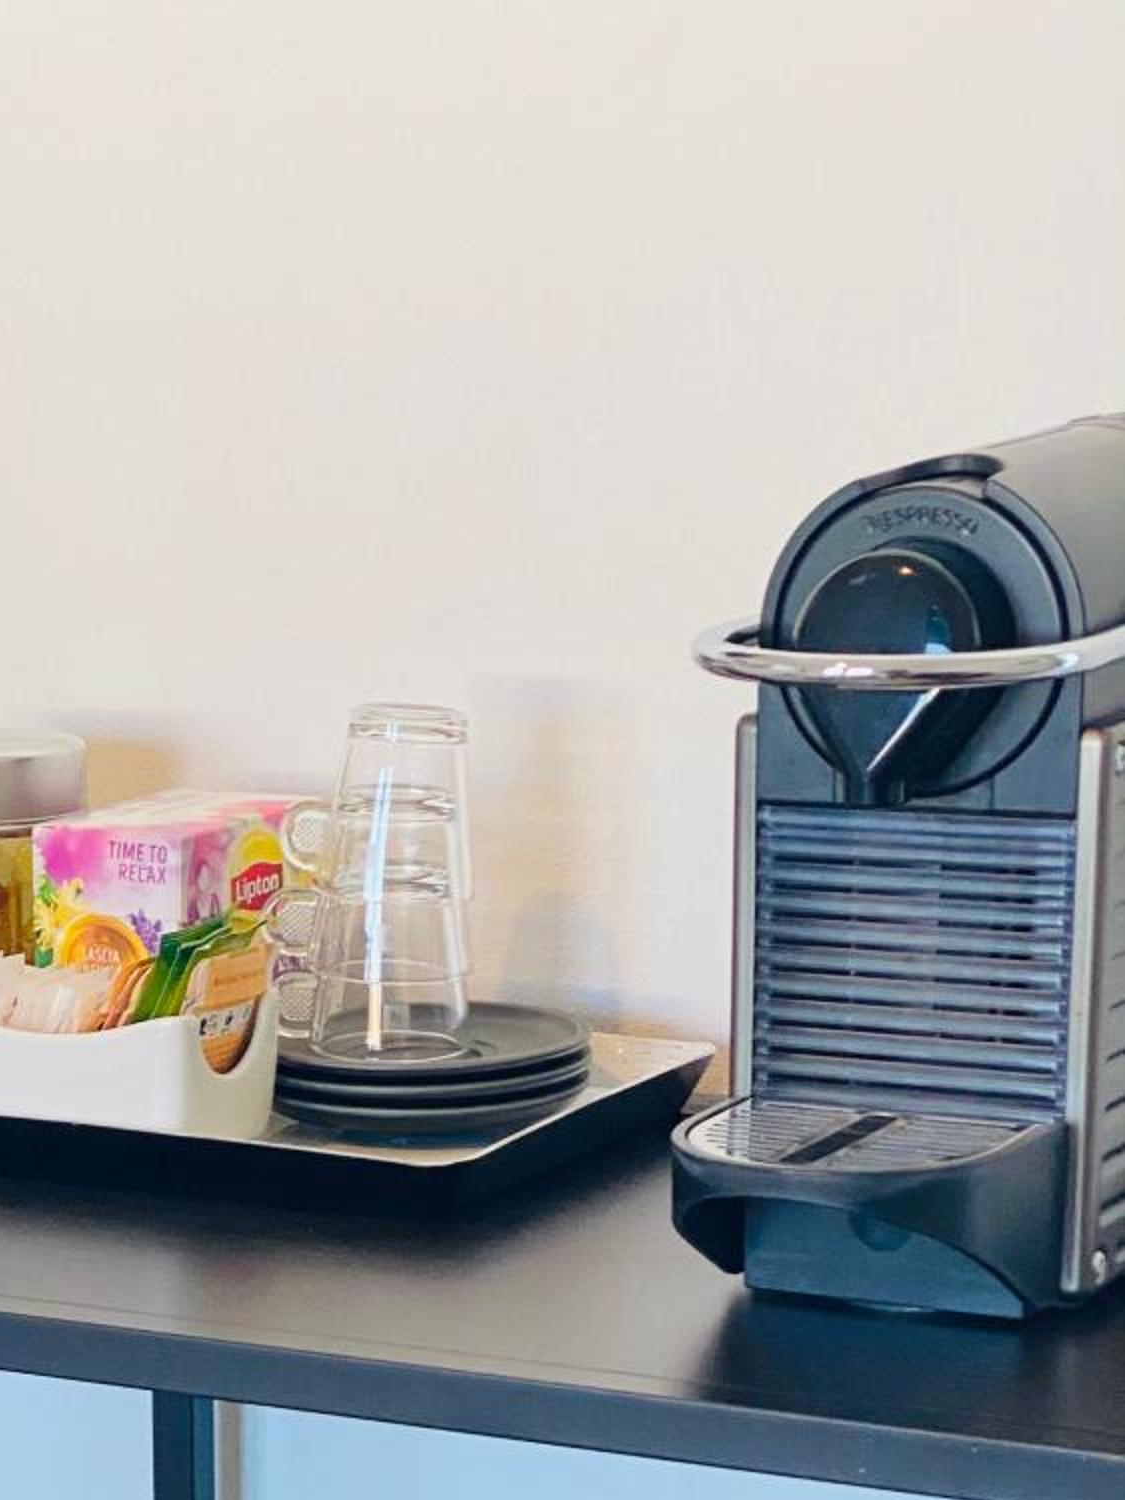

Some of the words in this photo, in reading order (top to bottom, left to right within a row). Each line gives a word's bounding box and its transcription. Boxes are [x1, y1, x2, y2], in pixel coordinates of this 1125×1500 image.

[108, 840, 144, 861] TIME
[150, 845, 168, 864] TO
[118, 863, 167, 884] RELAX
[235, 872, 280, 904] Lipton
